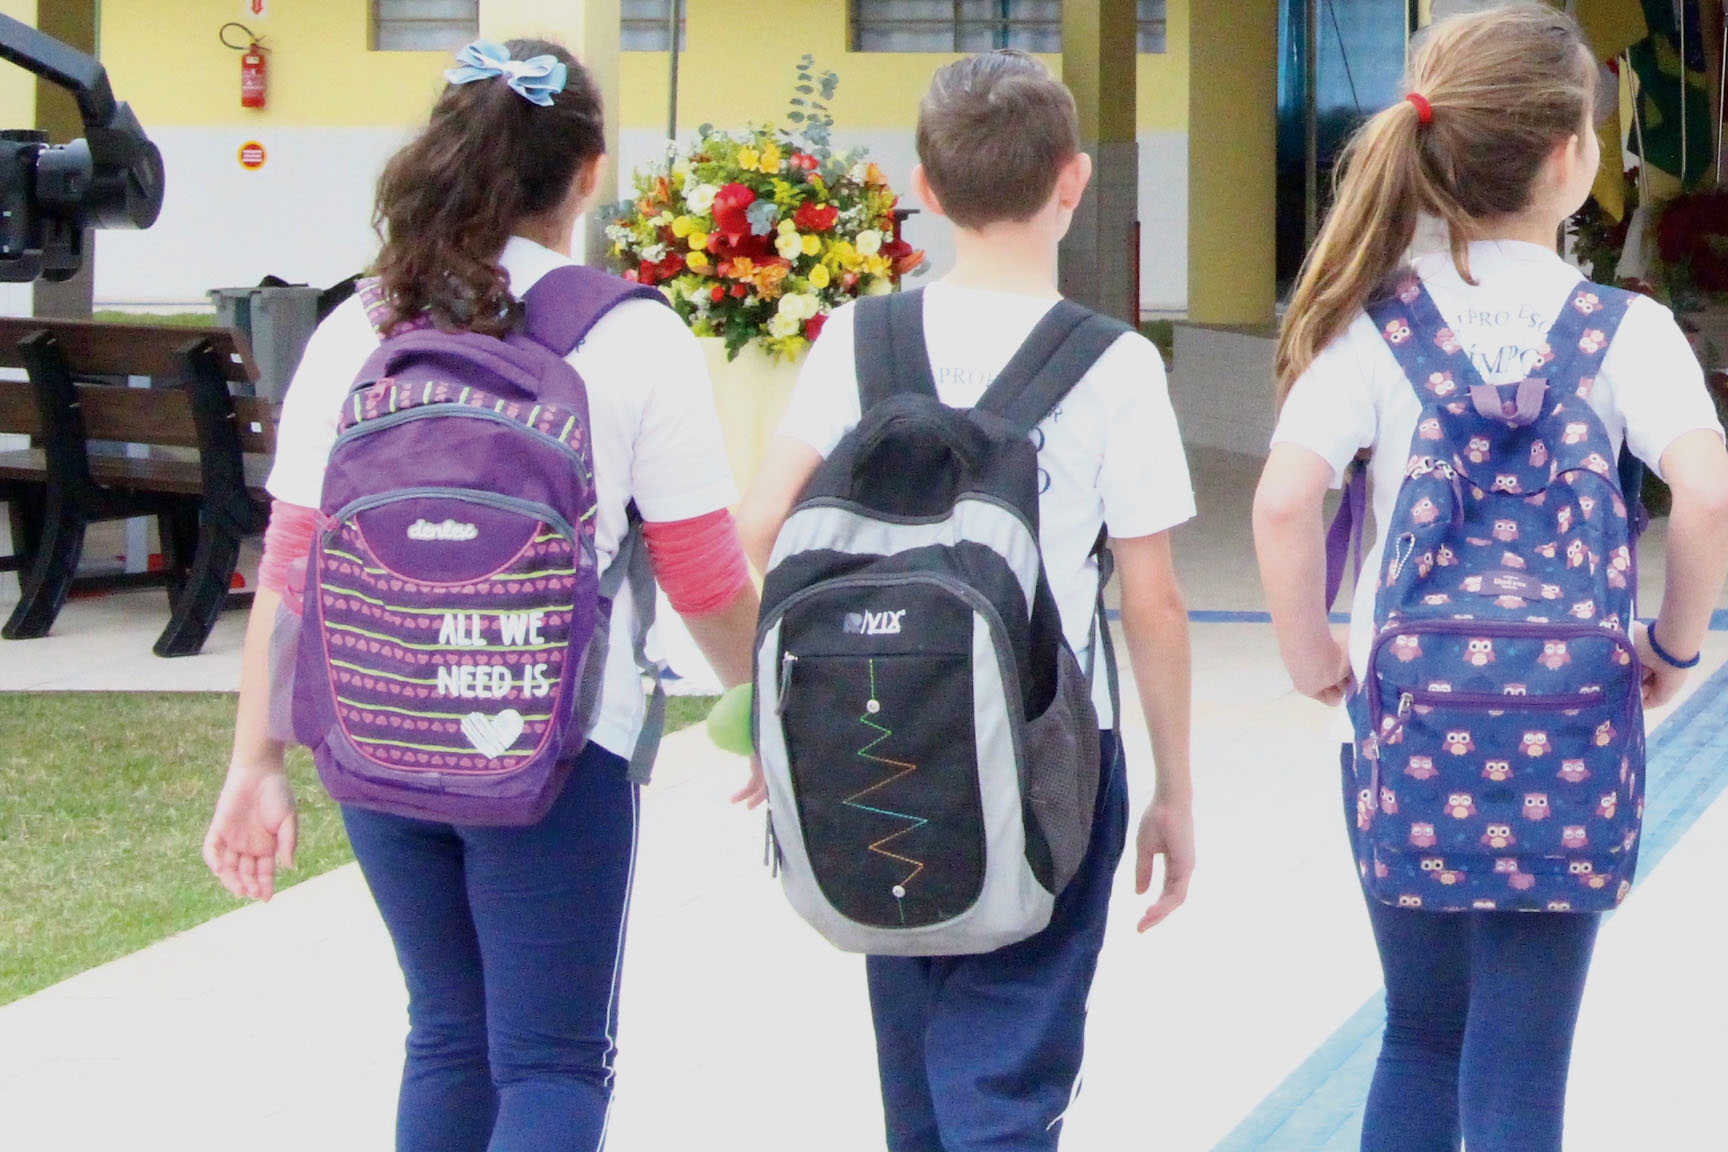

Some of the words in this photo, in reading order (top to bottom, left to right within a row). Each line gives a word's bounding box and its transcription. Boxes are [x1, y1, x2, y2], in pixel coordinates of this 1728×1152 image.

[438, 612, 488, 647] ALL
[499, 610, 545, 647] WE
[437, 663, 513, 699] NEED
[523, 662, 550, 698] IS
